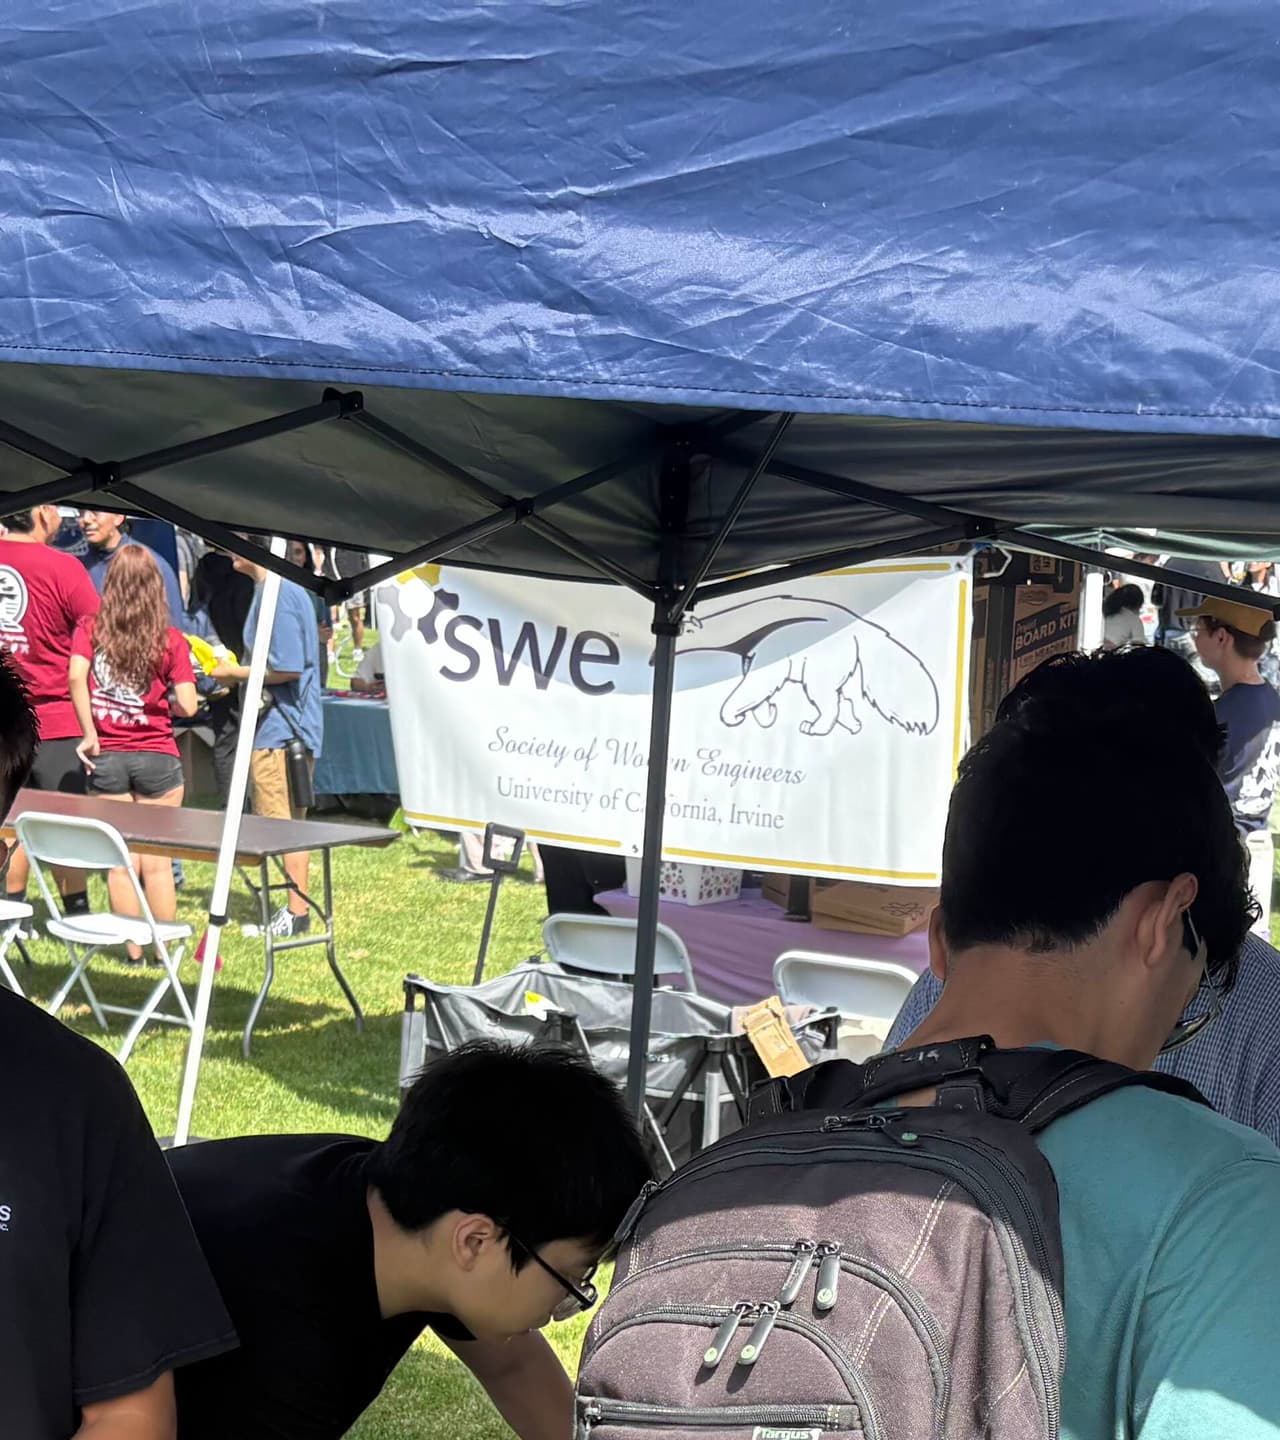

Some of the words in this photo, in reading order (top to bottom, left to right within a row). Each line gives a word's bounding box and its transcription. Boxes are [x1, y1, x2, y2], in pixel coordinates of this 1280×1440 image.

[439, 614, 621, 696] swe
[1015, 621, 1057, 650] BOARD
[1060, 611, 1079, 630] KIT
[488, 726, 569, 768] Society
[574, 737, 600, 771] of
[696, 748, 806, 787] Engineers
[497, 776, 593, 812] University
[599, 788, 623, 812] of
[729, 803, 784, 829] Irvine
[761, 1428, 809, 1440] Targus
